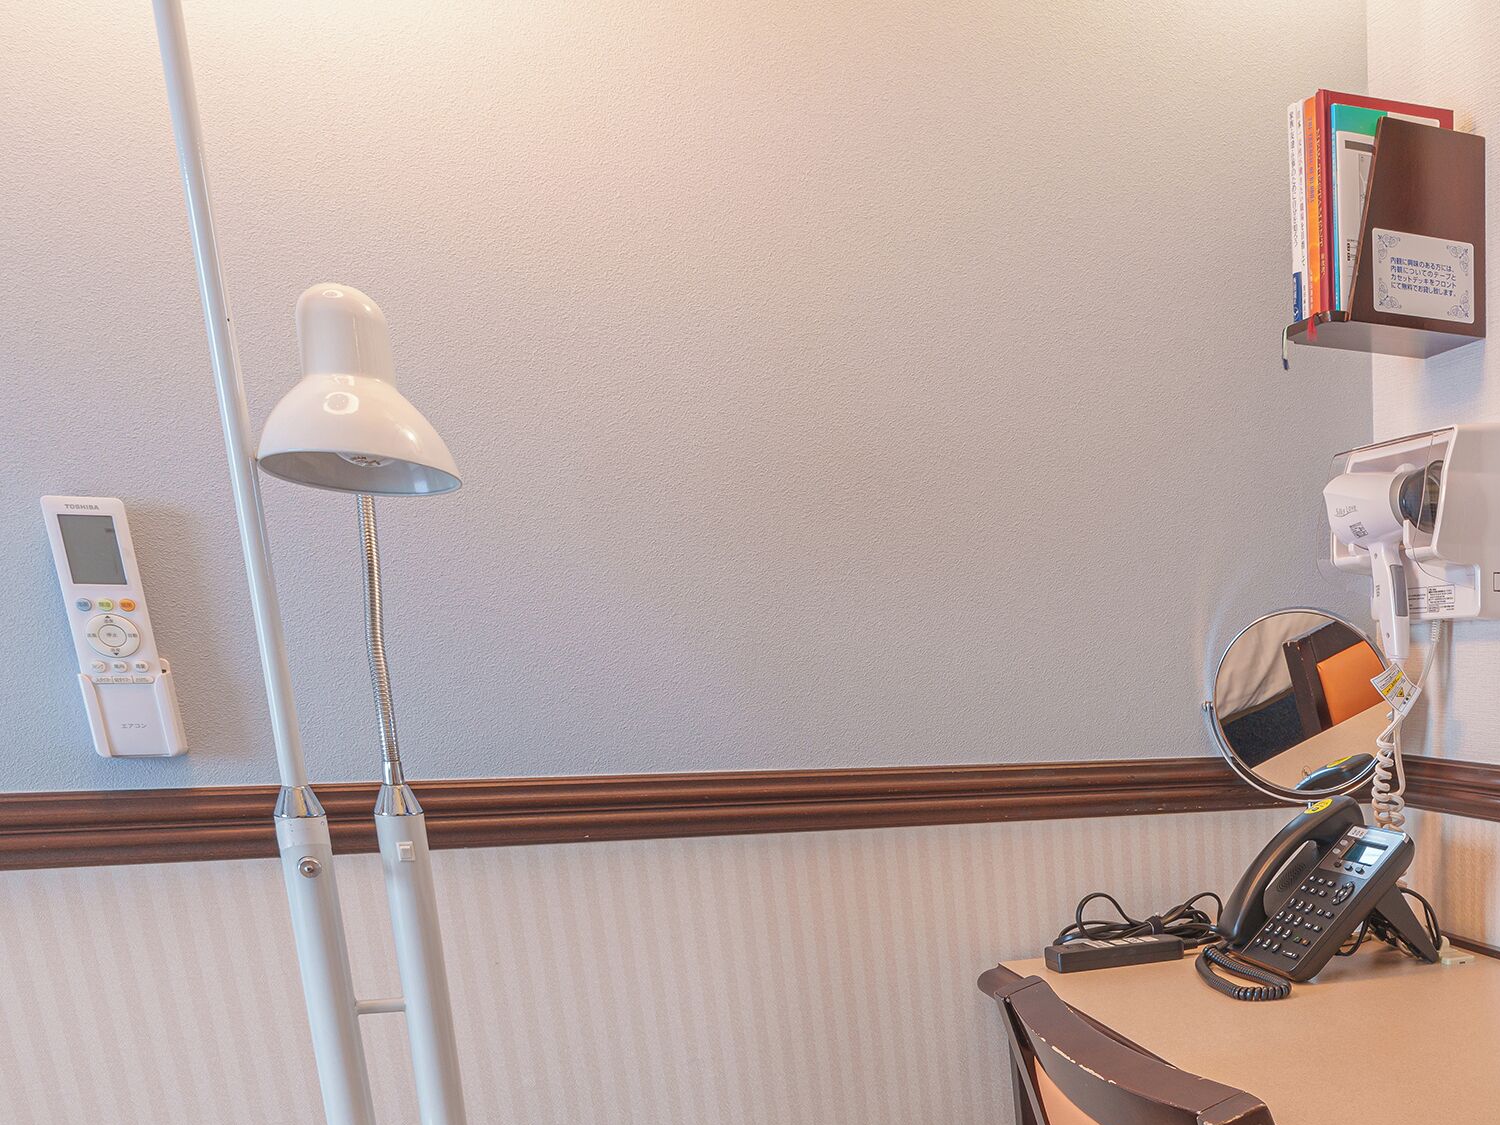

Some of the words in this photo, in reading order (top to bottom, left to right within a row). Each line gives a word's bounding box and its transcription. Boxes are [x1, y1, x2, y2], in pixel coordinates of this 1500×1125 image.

[64, 503, 100, 511] TOSHIBA
[120, 722, 148, 730] エアコン
